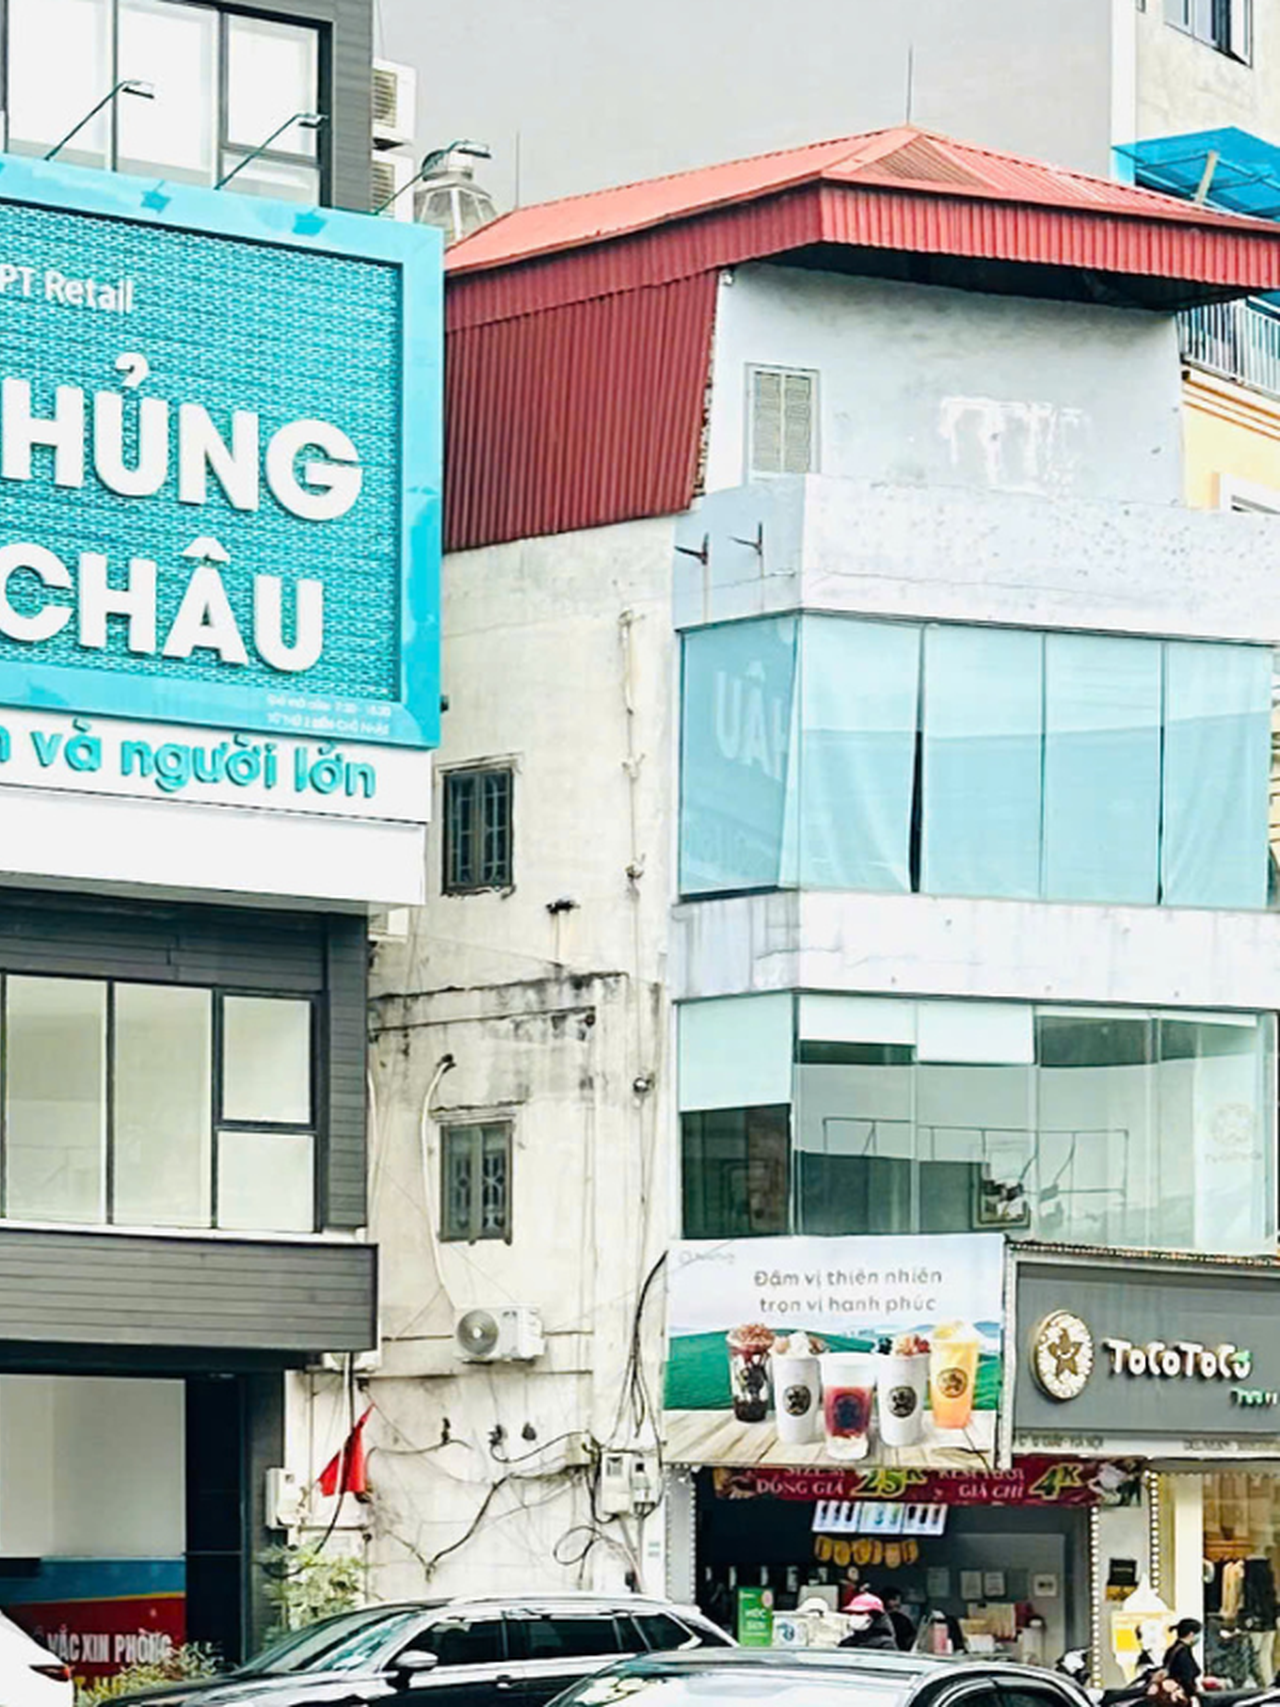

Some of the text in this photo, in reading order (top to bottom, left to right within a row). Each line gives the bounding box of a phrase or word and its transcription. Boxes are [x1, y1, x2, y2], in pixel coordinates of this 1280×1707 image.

[44, 270, 135, 315] Retail
[31, 719, 103, 772] và
[121, 734, 278, 792] người
[295, 741, 377, 799] lớn
[885, 1296, 936, 1315] phúc
[812, 1477, 845, 1495] GIÁ
[81, 1633, 110, 1663] XIN
